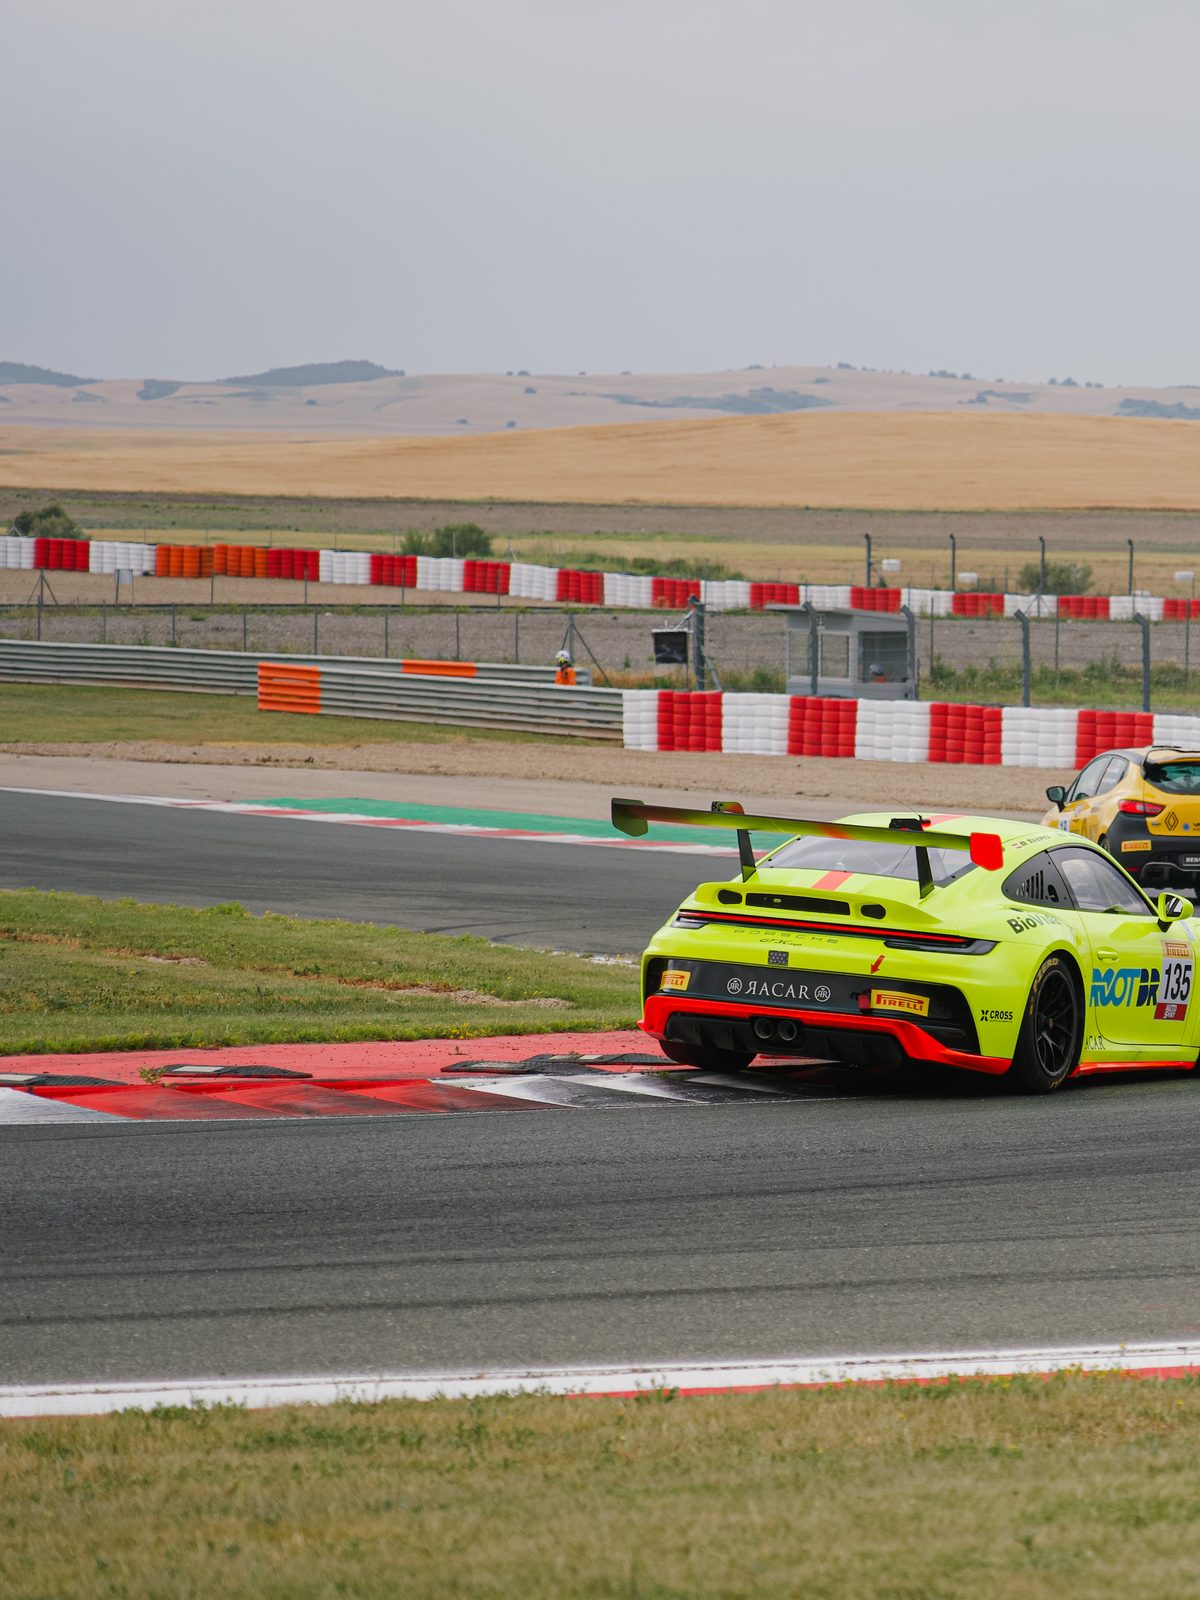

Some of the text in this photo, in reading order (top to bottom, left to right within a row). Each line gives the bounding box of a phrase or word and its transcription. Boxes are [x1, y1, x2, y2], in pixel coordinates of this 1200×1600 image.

[734, 929, 839, 944] PORSCHE
[1165, 943, 1189, 957] PIRELLI
[1164, 963, 1192, 1001] 135
[876, 993, 924, 1011] PIRELLI
